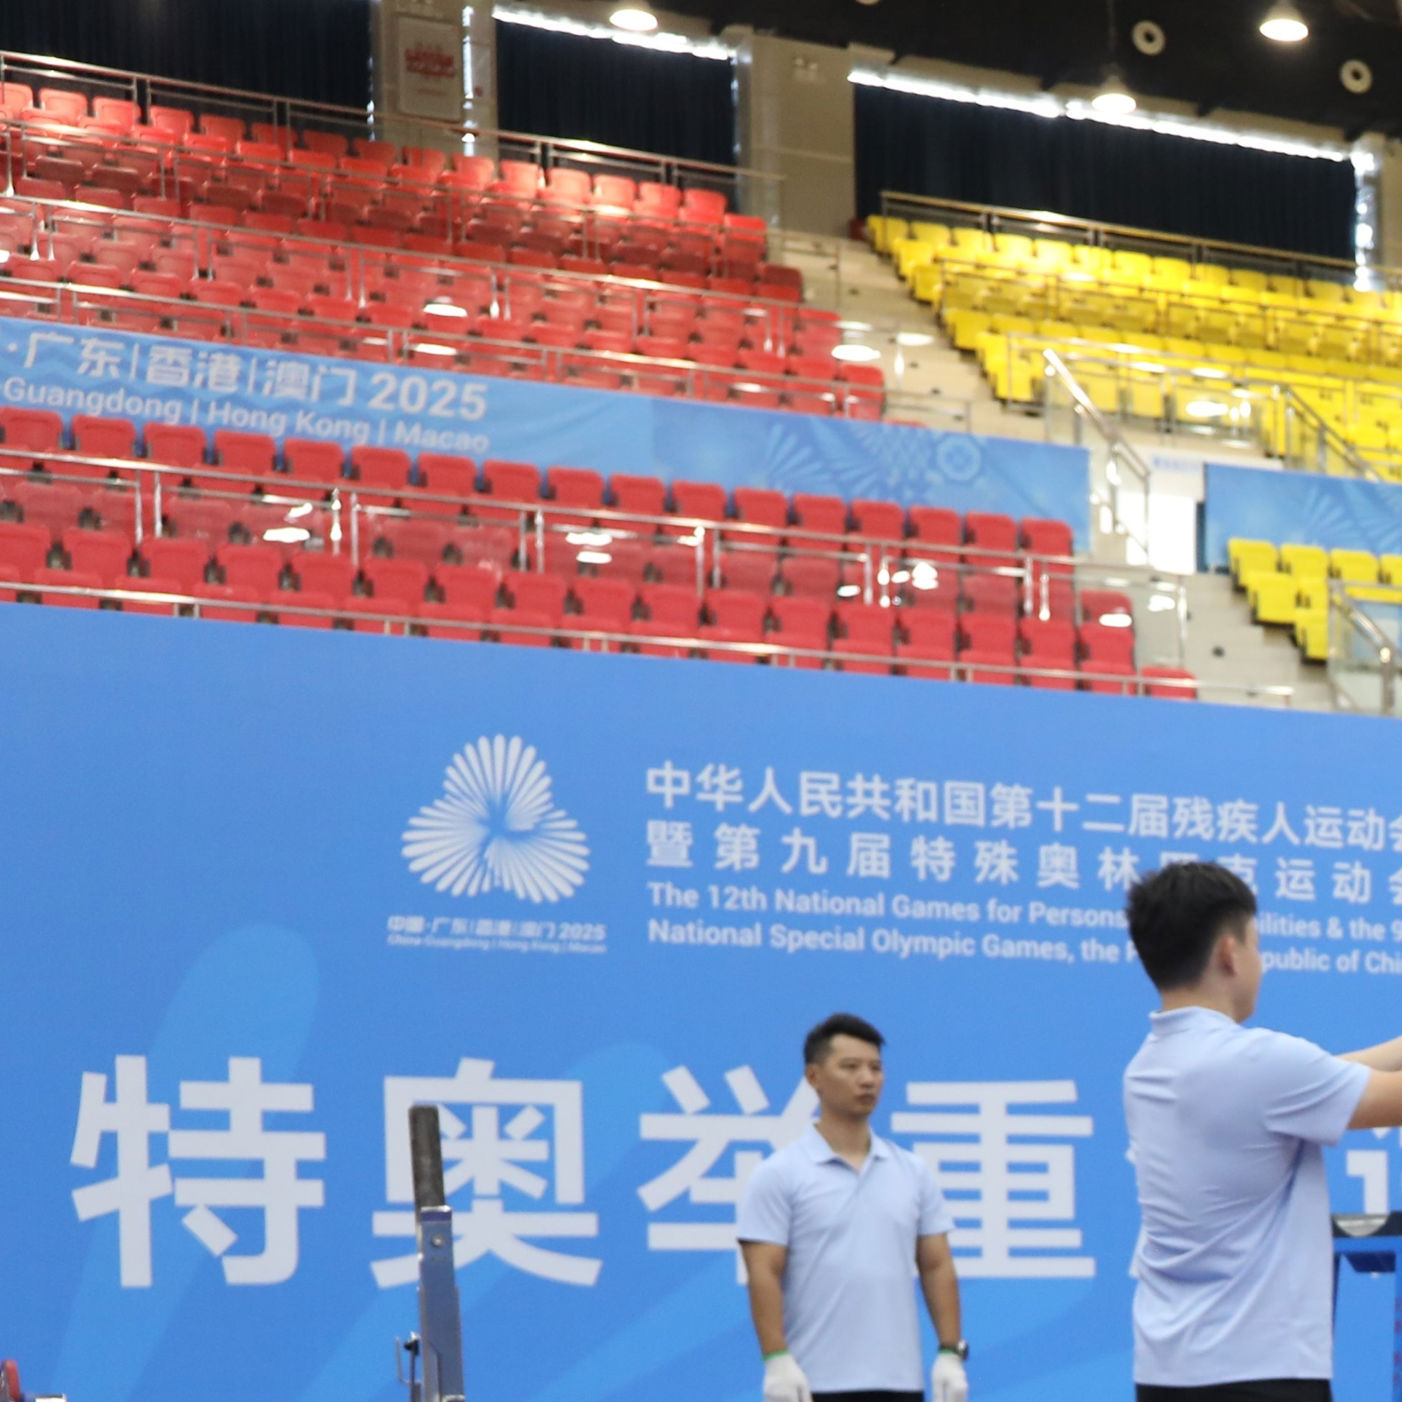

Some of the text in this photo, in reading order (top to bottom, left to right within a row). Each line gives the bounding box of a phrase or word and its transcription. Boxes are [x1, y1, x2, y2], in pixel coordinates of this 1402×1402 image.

[3, 377, 182, 425] Guangdong
[206, 400, 286, 437] Hong
[294, 411, 370, 446] Kong
[393, 420, 490, 454] Macao
[369, 372, 488, 421] 2025
[558, 922, 607, 941] 2025
[646, 881, 699, 909] The
[707, 884, 768, 912] 12th
[774, 888, 885, 917] National
[892, 894, 981, 923] Games
[986, 897, 1023, 924] for
[1028, 902, 1130, 929] Persons
[1256, 911, 1322, 938] ilities
[1326, 914, 1345, 938] &
[1348, 917, 1385, 940] the
[647, 918, 762, 948] National
[769, 924, 866, 954] Special
[871, 928, 976, 961] Olympic
[981, 933, 1076, 965] Games,
[1080, 939, 1121, 963] the
[1261, 948, 1330, 975] public
[1336, 950, 1360, 973] of
